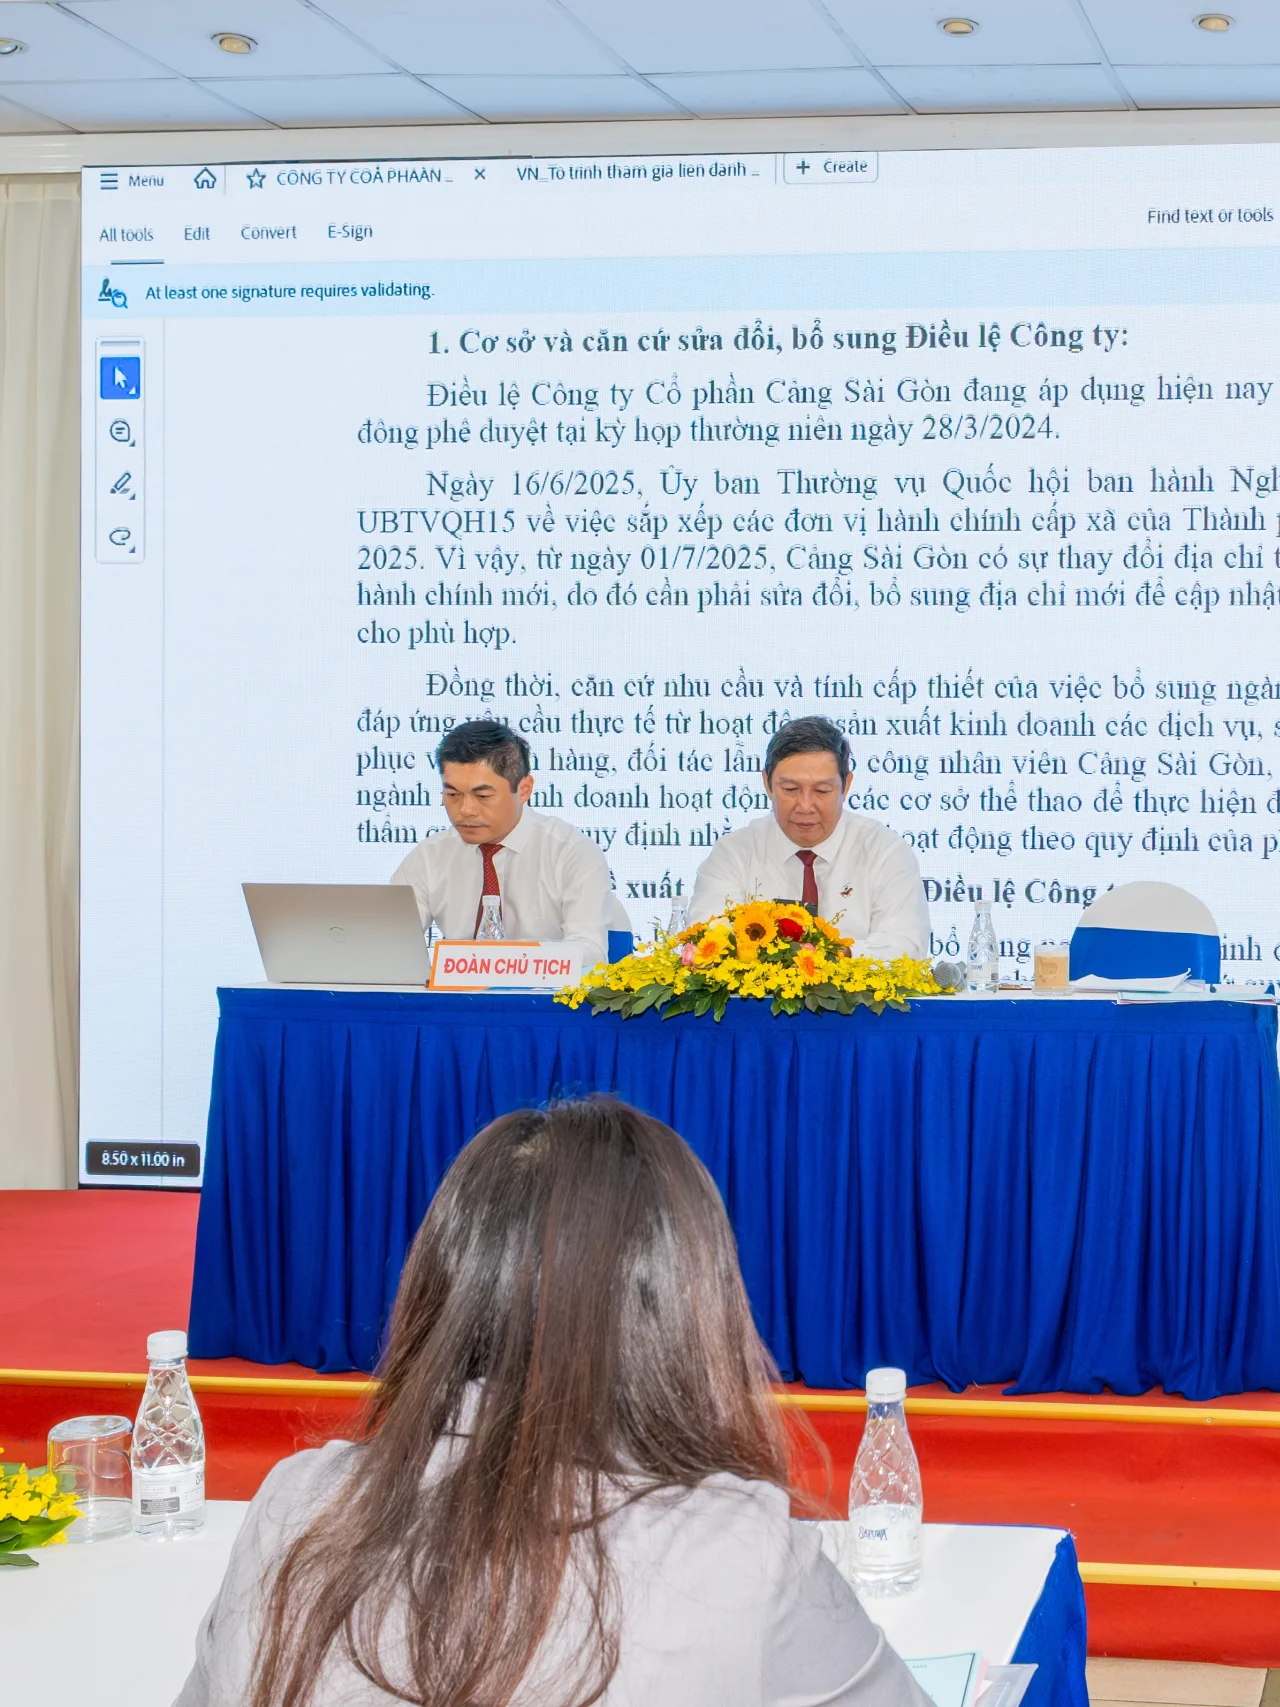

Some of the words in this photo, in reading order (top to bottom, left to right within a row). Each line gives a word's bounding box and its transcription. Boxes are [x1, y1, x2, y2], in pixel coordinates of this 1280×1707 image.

[326, 168, 347, 185] TY
[823, 158, 869, 174] Create
[128, 173, 165, 188] Menu
[1147, 206, 1180, 224] Find
[1184, 206, 1214, 224] text
[1218, 208, 1233, 223] or
[1237, 204, 1274, 223] tools
[99, 227, 119, 242] All
[121, 226, 154, 242] tools
[184, 224, 211, 241] Edit
[240, 224, 297, 241] Convert
[327, 222, 374, 243] E-Sign
[146, 285, 162, 300] At
[164, 284, 198, 300] least
[201, 286, 228, 299] one
[231, 284, 297, 303] signature
[301, 283, 358, 303] requires
[361, 281, 436, 302] validating.
[428, 330, 450, 355] 1.
[458, 329, 500, 355] Cơ
[505, 328, 537, 354] sở
[543, 328, 574, 353] và
[581, 329, 629, 353] căn
[637, 328, 671, 352] cứ
[833, 331, 897, 356] sung
[905, 318, 969, 349] Điều
[978, 321, 1002, 353] lệ
[1009, 321, 1084, 354] Công
[1092, 323, 1128, 353] ty:
[426, 375, 488, 408] Điều
[498, 380, 521, 411] lệ
[530, 381, 600, 413] Công
[609, 383, 635, 412] ty
[692, 371, 755, 412] phần
[844, 378, 885, 404] Sài
[896, 378, 952, 403] Gòn
[962, 376, 1027, 409] đang
[1038, 377, 1069, 408] áp
[1080, 375, 1146, 408] dụng
[1157, 374, 1214, 405] hiện
[1225, 381, 1274, 406] nay
[356, 418, 419, 451] đông
[426, 417, 472, 451] phê
[478, 417, 548, 450] duyệt
[556, 416, 587, 447] tại
[594, 416, 627, 449] kỳ
[634, 415, 682, 449] họp
[689, 409, 781, 448] thường
[787, 414, 843, 442] niên
[850, 415, 914, 447] ngày
[922, 413, 1060, 441] 28/3/2024.
[425, 470, 495, 503] Ngày
[513, 469, 643, 497] 16/6/2025,
[713, 468, 761, 495] ban
[776, 468, 878, 501] Thường
[893, 475, 927, 498] vụ
[942, 462, 1012, 501] Quốc
[1028, 466, 1070, 497] hội
[1087, 467, 1134, 494] ban
[1150, 465, 1215, 493] hành
[356, 619, 401, 645] cho
[408, 618, 456, 651] phù
[463, 618, 517, 651] hợp.
[425, 665, 496, 703] Đồng
[504, 671, 561, 706] thời,
[570, 674, 615, 698] căn
[623, 673, 656, 698] cứ
[663, 672, 711, 698] nhu
[720, 665, 765, 698] cầu
[773, 673, 804, 698] và
[813, 673, 864, 699] tính
[872, 666, 918, 705] cấp
[927, 667, 985, 699] thiết
[1048, 673, 1102, 704] việc
[1155, 680, 1217, 706] sung
[625, 868, 685, 899] xuất
[993, 877, 1016, 909] lệ
[1024, 877, 1097, 910] Công
[1219, 932, 1263, 964] inh
[443, 952, 492, 976] ĐOÀN
[494, 952, 529, 975] CHỦ
[533, 958, 572, 980] TỊCH
[101, 1150, 129, 1166] 8.50
[130, 1154, 139, 1166] x
[140, 1151, 170, 1167] 11.00
[172, 1152, 185, 1167] in
